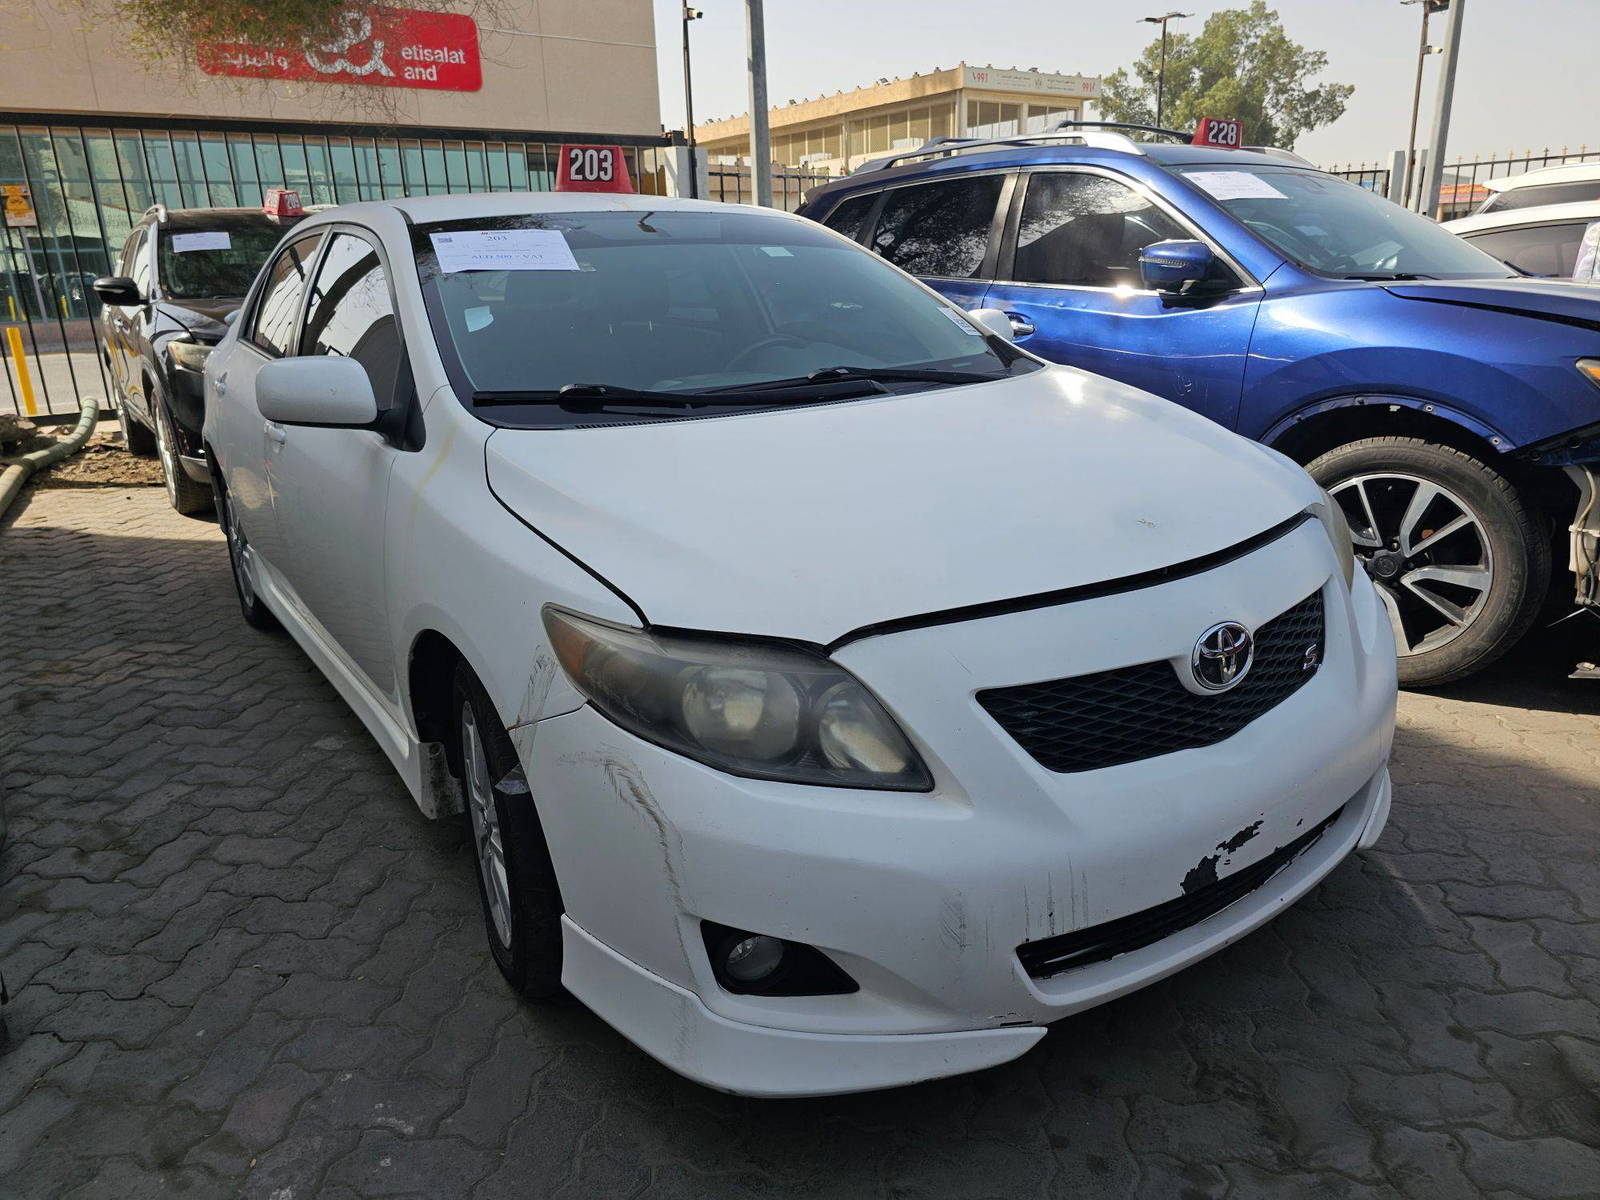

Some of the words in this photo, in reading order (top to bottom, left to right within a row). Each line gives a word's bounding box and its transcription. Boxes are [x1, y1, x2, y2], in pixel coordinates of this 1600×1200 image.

[401, 44, 466, 64] etisalat
[404, 65, 437, 81] and
[1208, 121, 1237, 145] 228
[570, 148, 612, 181] 203
